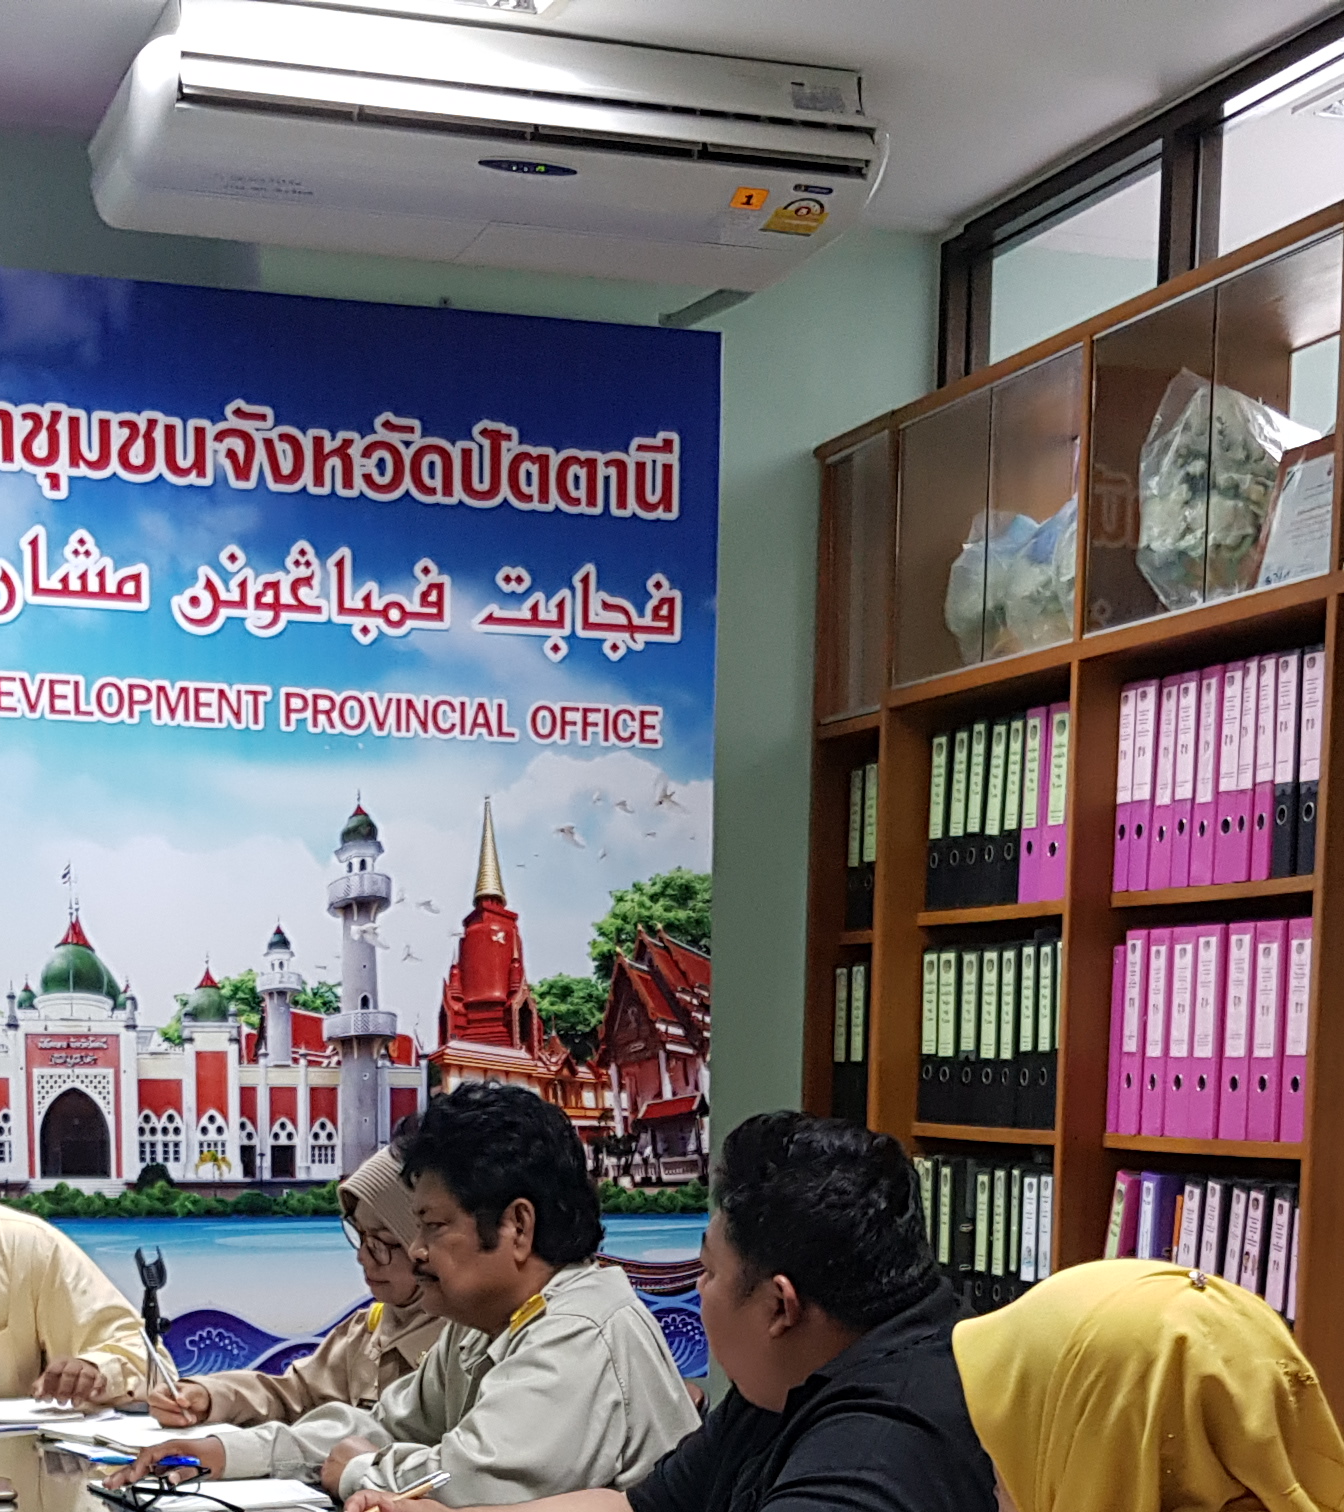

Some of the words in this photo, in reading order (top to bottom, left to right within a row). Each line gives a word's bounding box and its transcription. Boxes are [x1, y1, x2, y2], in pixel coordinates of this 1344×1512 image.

[740, 193, 755, 206] 1
[285, 692, 516, 738] PROVINCIAL
[531, 704, 660, 745] OFFICE
